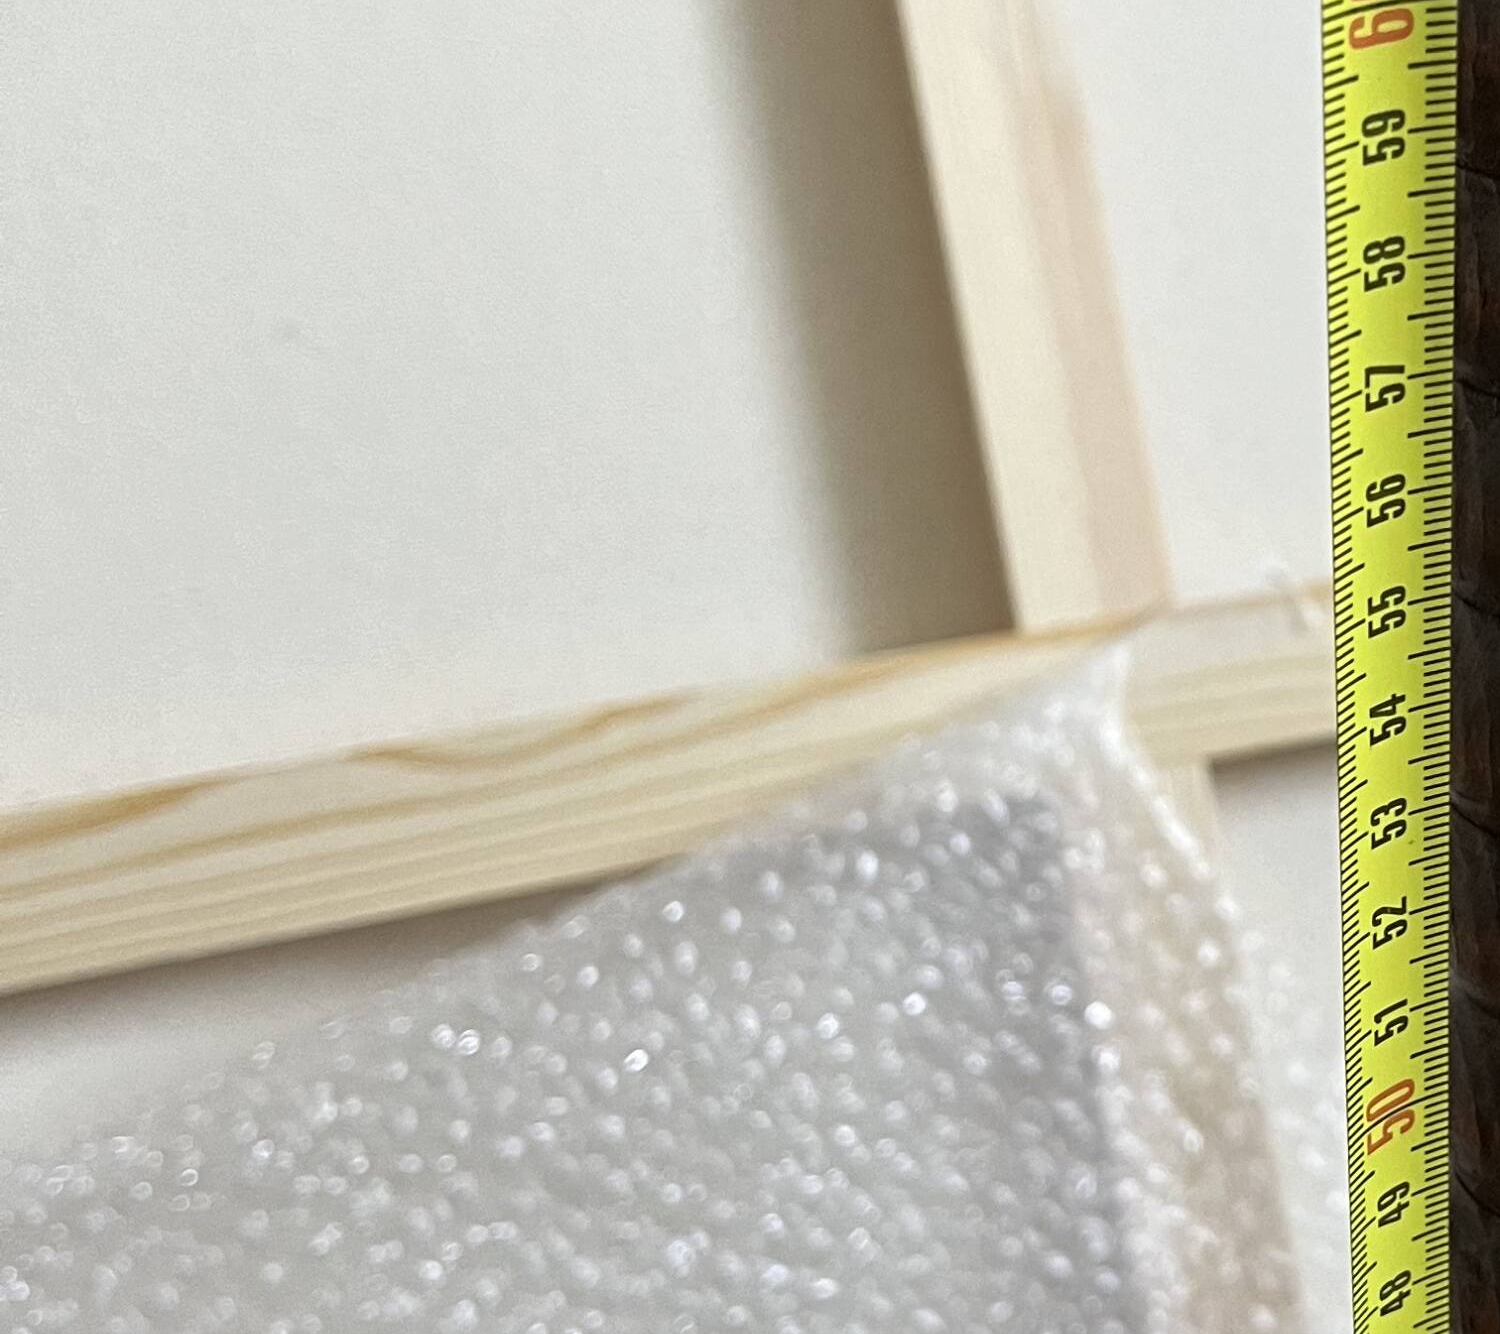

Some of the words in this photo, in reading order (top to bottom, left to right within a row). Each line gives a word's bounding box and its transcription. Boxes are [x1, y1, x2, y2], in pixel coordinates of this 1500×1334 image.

[1362, 109, 1406, 166] 59
[1363, 235, 1406, 293] 58
[1364, 364, 1406, 412] 57
[1366, 473, 1406, 528] 56
[1368, 585, 1406, 638] 55
[1369, 693, 1406, 747] 54
[1370, 797, 1407, 849] 53
[1372, 896, 1408, 950] 52
[1374, 998, 1409, 1047] 51
[1366, 1078, 1415, 1155] 50
[1377, 1181, 1410, 1227] 49
[1380, 1270, 1411, 1317] 48
